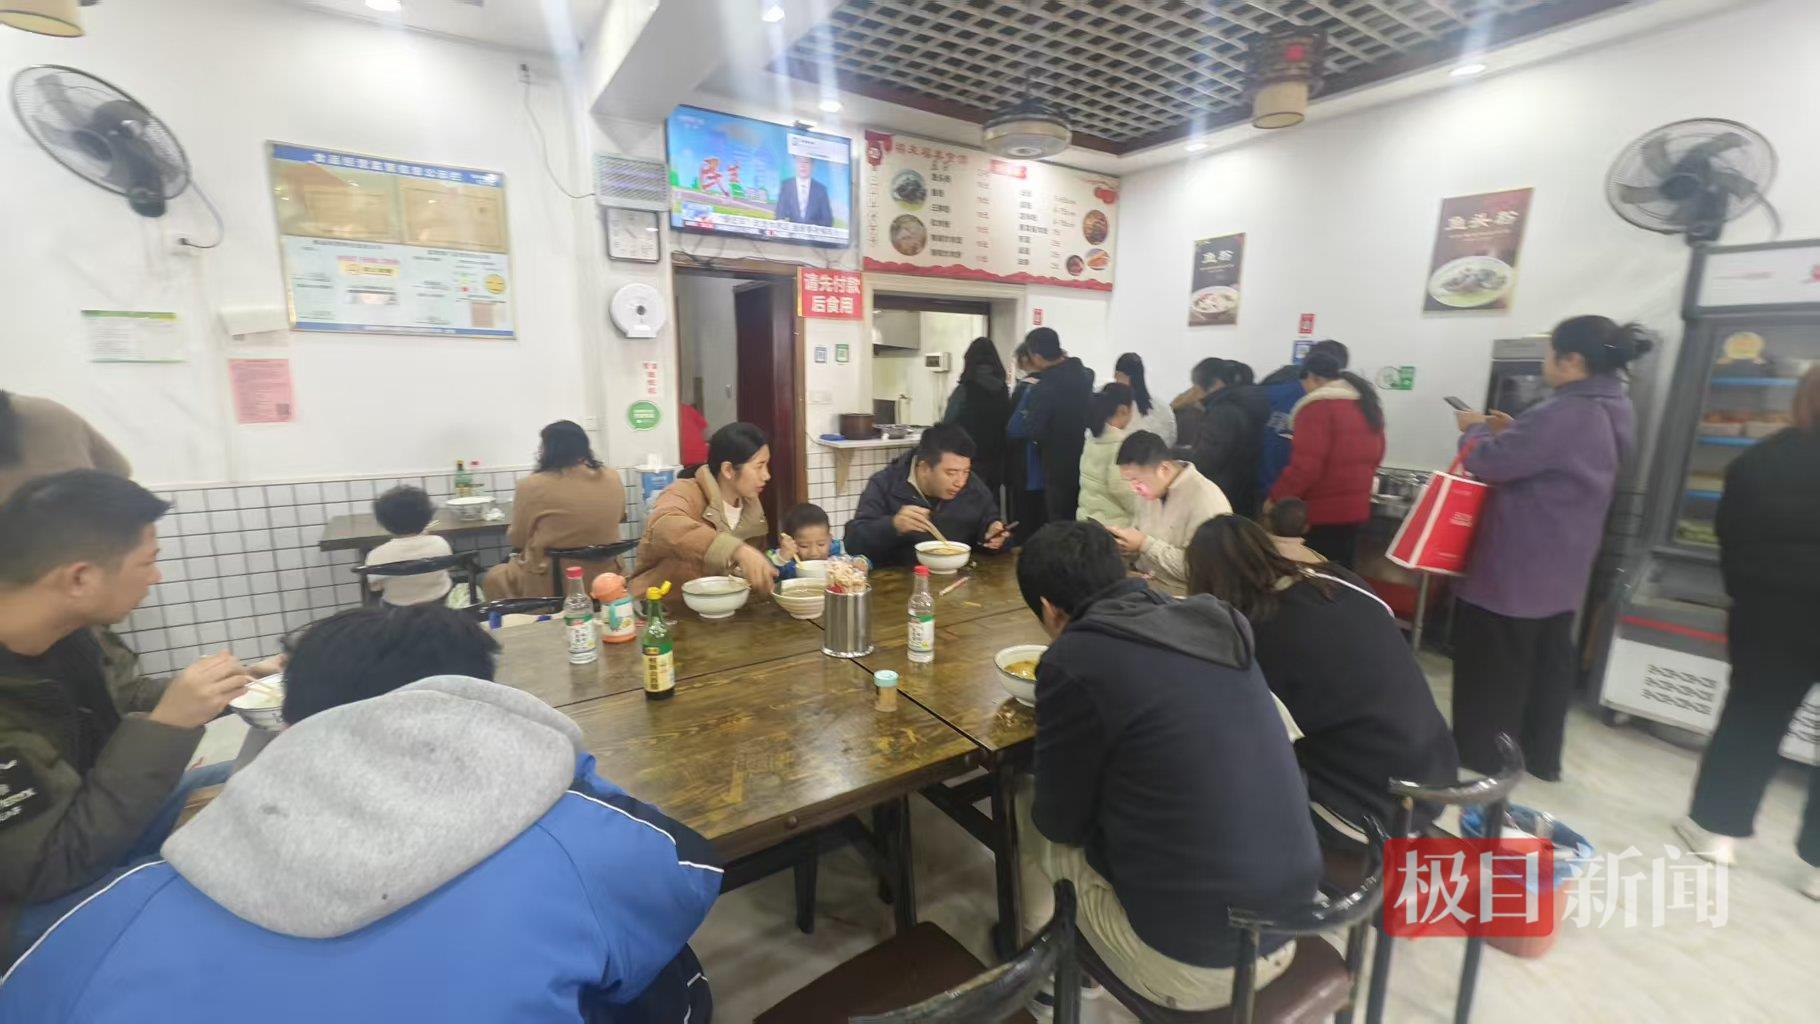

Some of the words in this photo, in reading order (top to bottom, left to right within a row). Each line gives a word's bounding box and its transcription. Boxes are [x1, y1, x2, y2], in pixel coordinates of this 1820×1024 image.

[803, 272, 860, 294] 请先付款
[811, 295, 854, 314] 后食用
